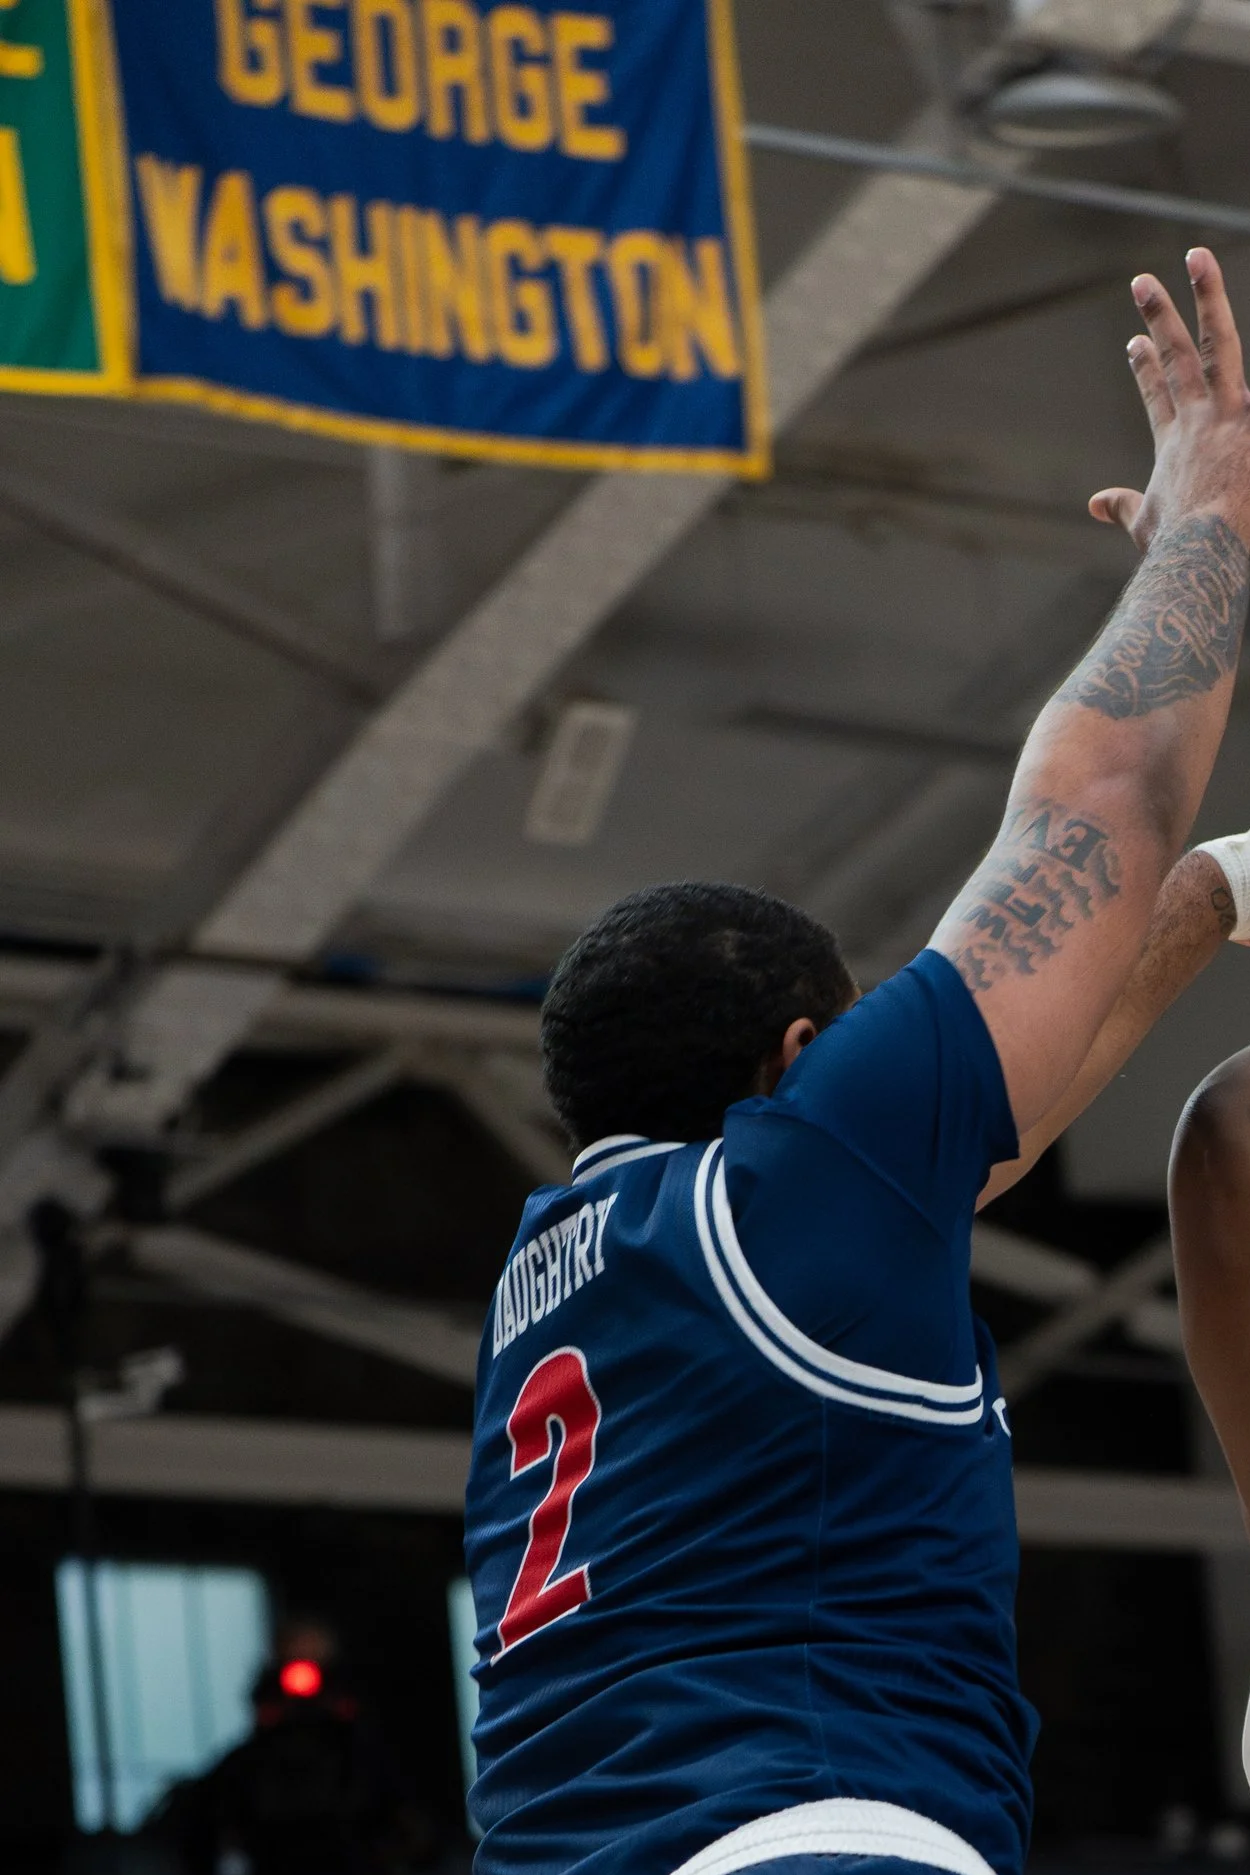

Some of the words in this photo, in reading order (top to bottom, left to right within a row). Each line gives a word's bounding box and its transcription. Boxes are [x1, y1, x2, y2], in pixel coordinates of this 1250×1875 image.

[216, 0, 628, 163] GEORGE
[135, 152, 743, 383] WASHINGTON
[492, 1190, 620, 1361] DAUGHTRY
[490, 1345, 602, 1667] 2
